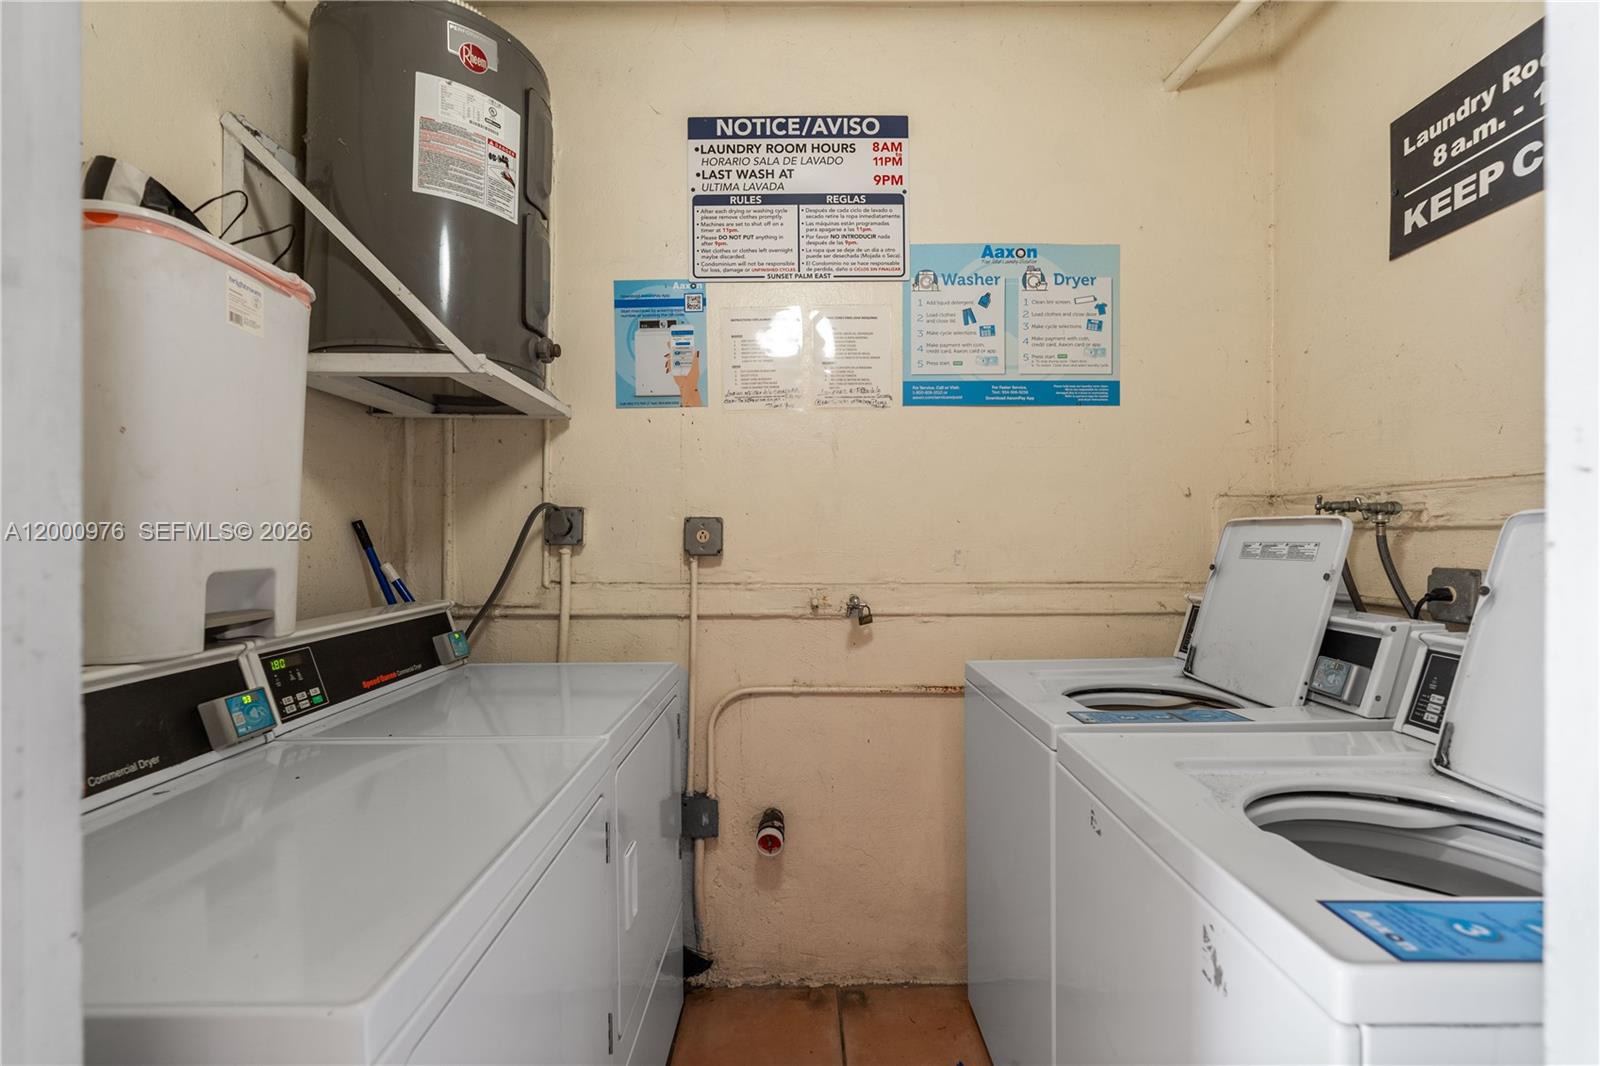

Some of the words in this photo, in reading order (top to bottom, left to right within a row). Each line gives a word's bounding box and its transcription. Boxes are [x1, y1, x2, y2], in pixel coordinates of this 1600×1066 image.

[1404, 84, 1496, 156] Laundry
[716, 118, 880, 136] NOTICE/AVISO
[701, 144, 761, 155] LAUNDRY
[768, 144, 806, 154] ROOM
[811, 143, 856, 153] HOURS
[873, 142, 903, 152] 8AM
[702, 157, 749, 166] HORARIO
[753, 157, 779, 166] SALA
[783, 157, 797, 165] DE
[801, 157, 843, 165] LAVADO
[873, 157, 903, 166] 11PM
[702, 170, 732, 180] LAST
[737, 169, 774, 179] WASH
[779, 169, 794, 178] AT
[874, 175, 903, 186] 9PM
[702, 183, 740, 192] ULTIMA
[743, 182, 784, 191] LAVADA
[730, 196, 762, 204] RULES
[826, 195, 866, 204] REGLAS
[1404, 161, 1504, 236] KEEP
[981, 245, 1038, 258] Aaxon
[941, 273, 1000, 286] Washer
[1054, 272, 1096, 289] Dryer
[88, 763, 137, 787] Commercial
[138, 756, 160, 770] Dryer
